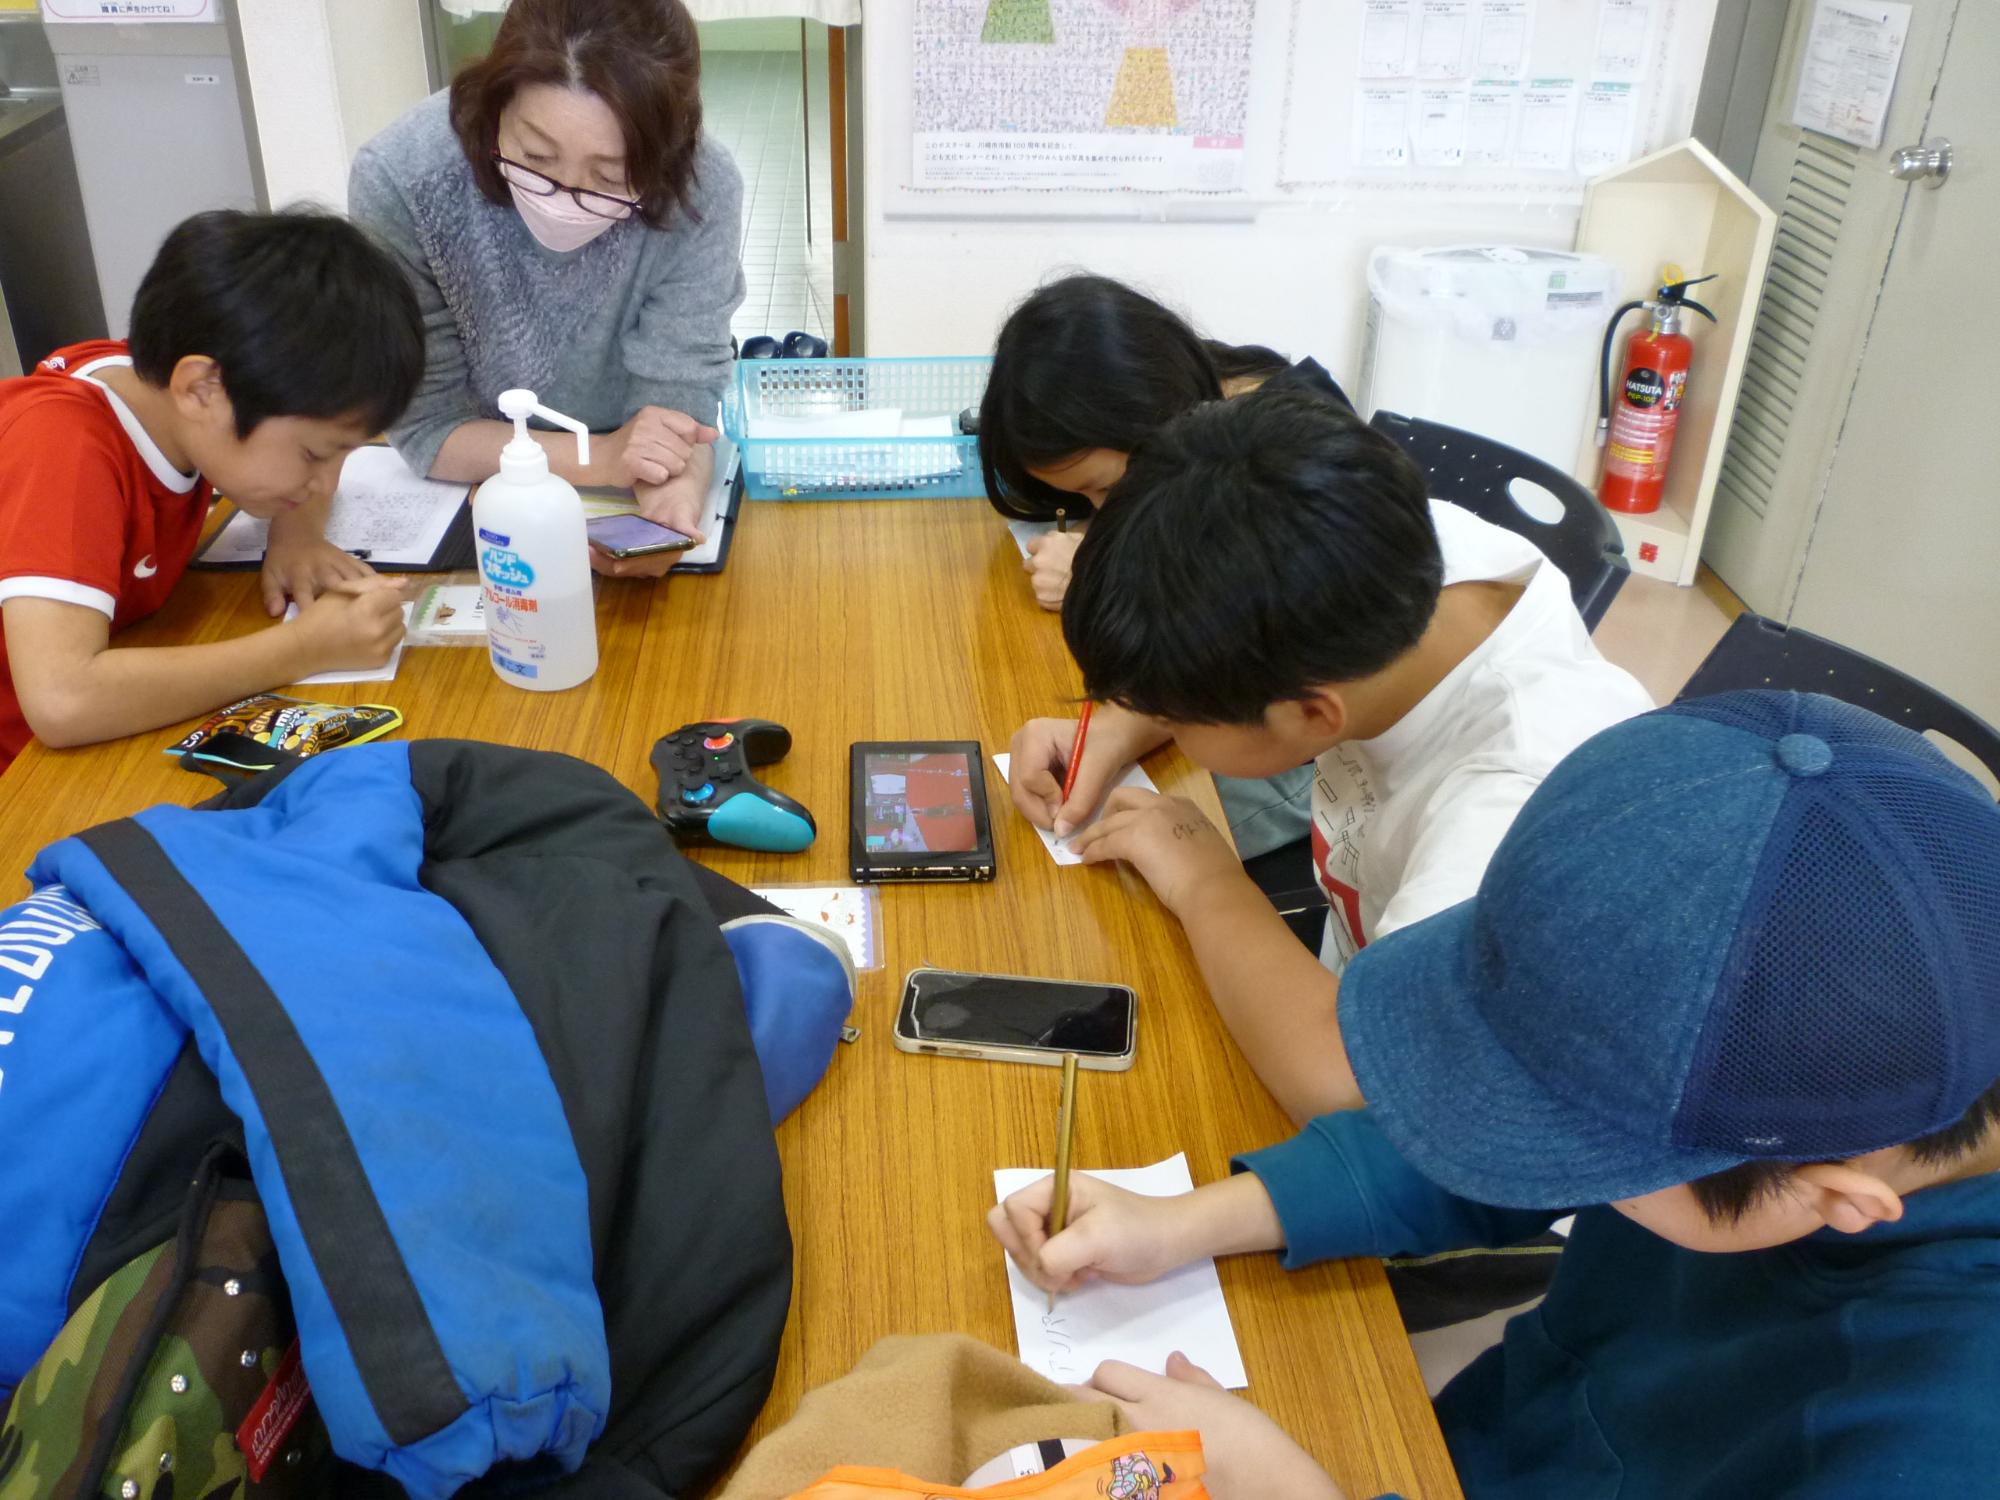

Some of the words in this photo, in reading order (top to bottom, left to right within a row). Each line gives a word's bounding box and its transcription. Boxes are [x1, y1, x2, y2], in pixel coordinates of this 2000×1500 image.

[1626, 380, 1662, 395] HATSUTA
[483, 586, 538, 613] アルコール消毒剤
